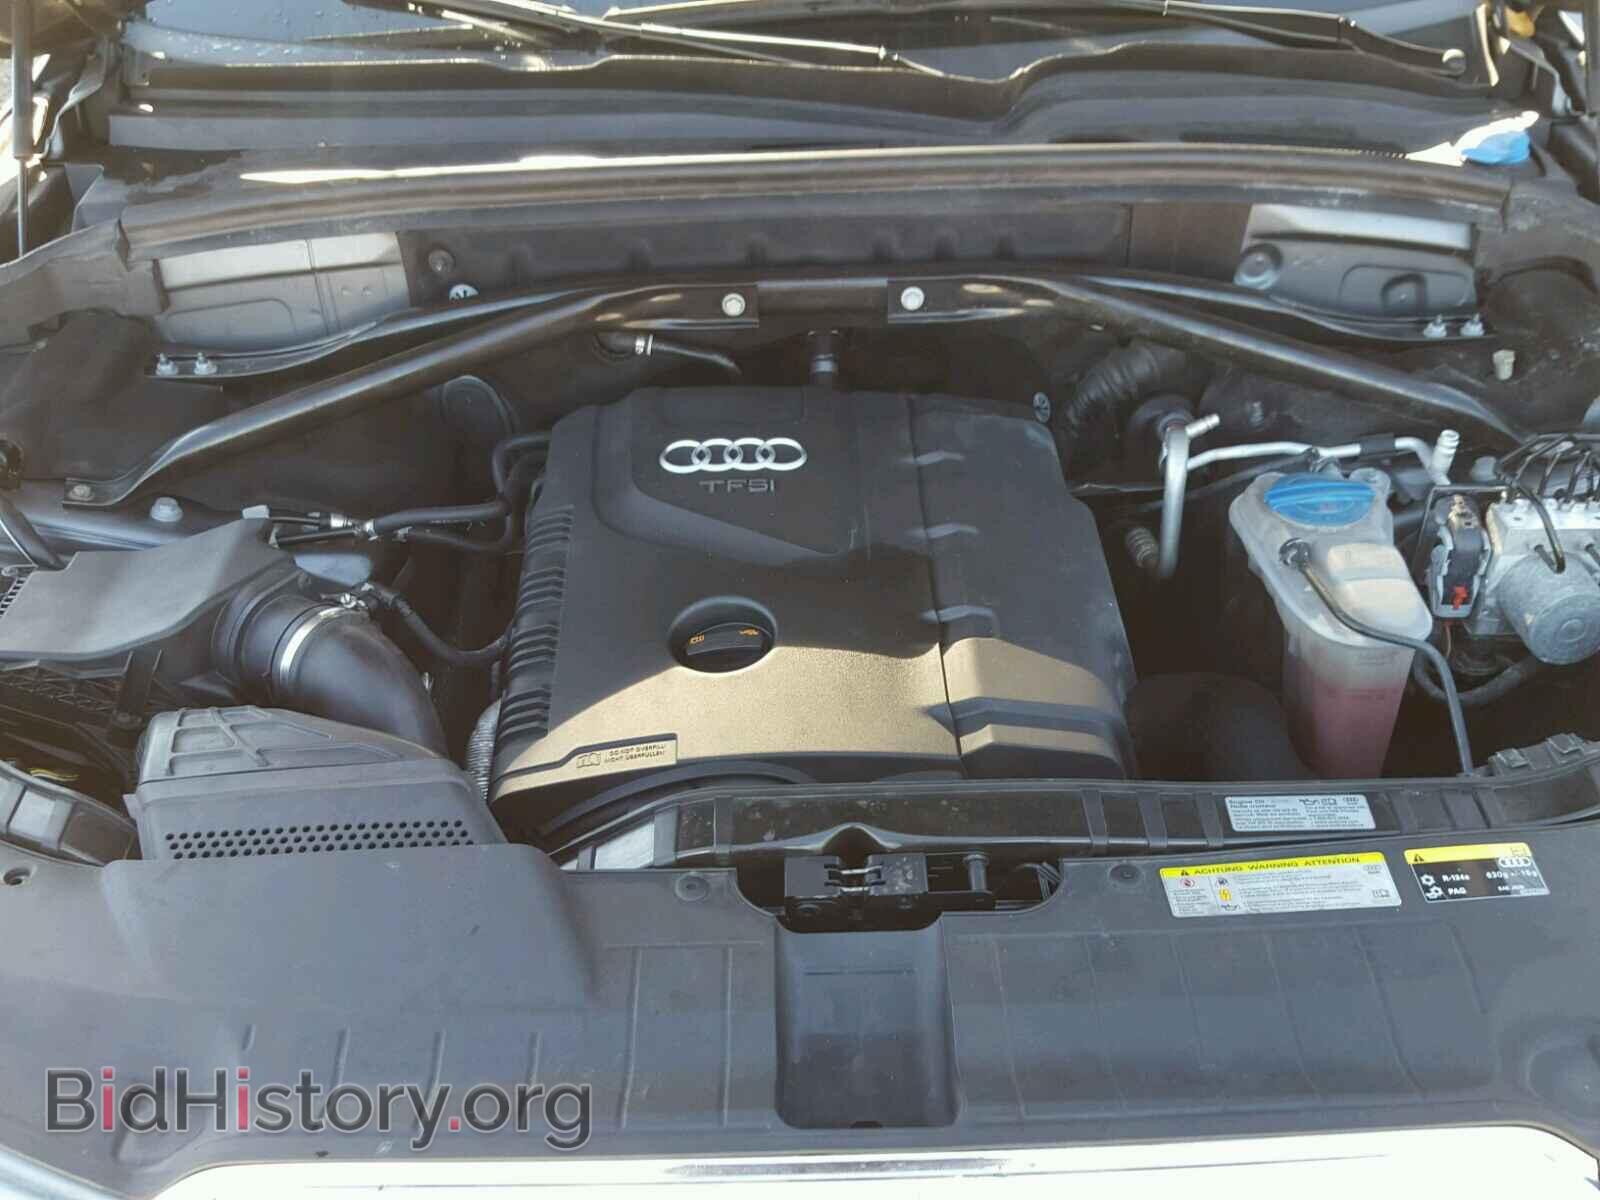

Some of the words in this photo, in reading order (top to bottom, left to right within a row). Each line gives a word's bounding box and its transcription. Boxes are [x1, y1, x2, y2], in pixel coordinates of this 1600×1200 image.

[699, 479, 775, 494] TFSI
[1194, 867, 1244, 875] ACHTUNG
[1248, 862, 1300, 871] WARNING
[1304, 857, 1360, 867] ATTENTION
[1447, 886, 1467, 895] PAG
